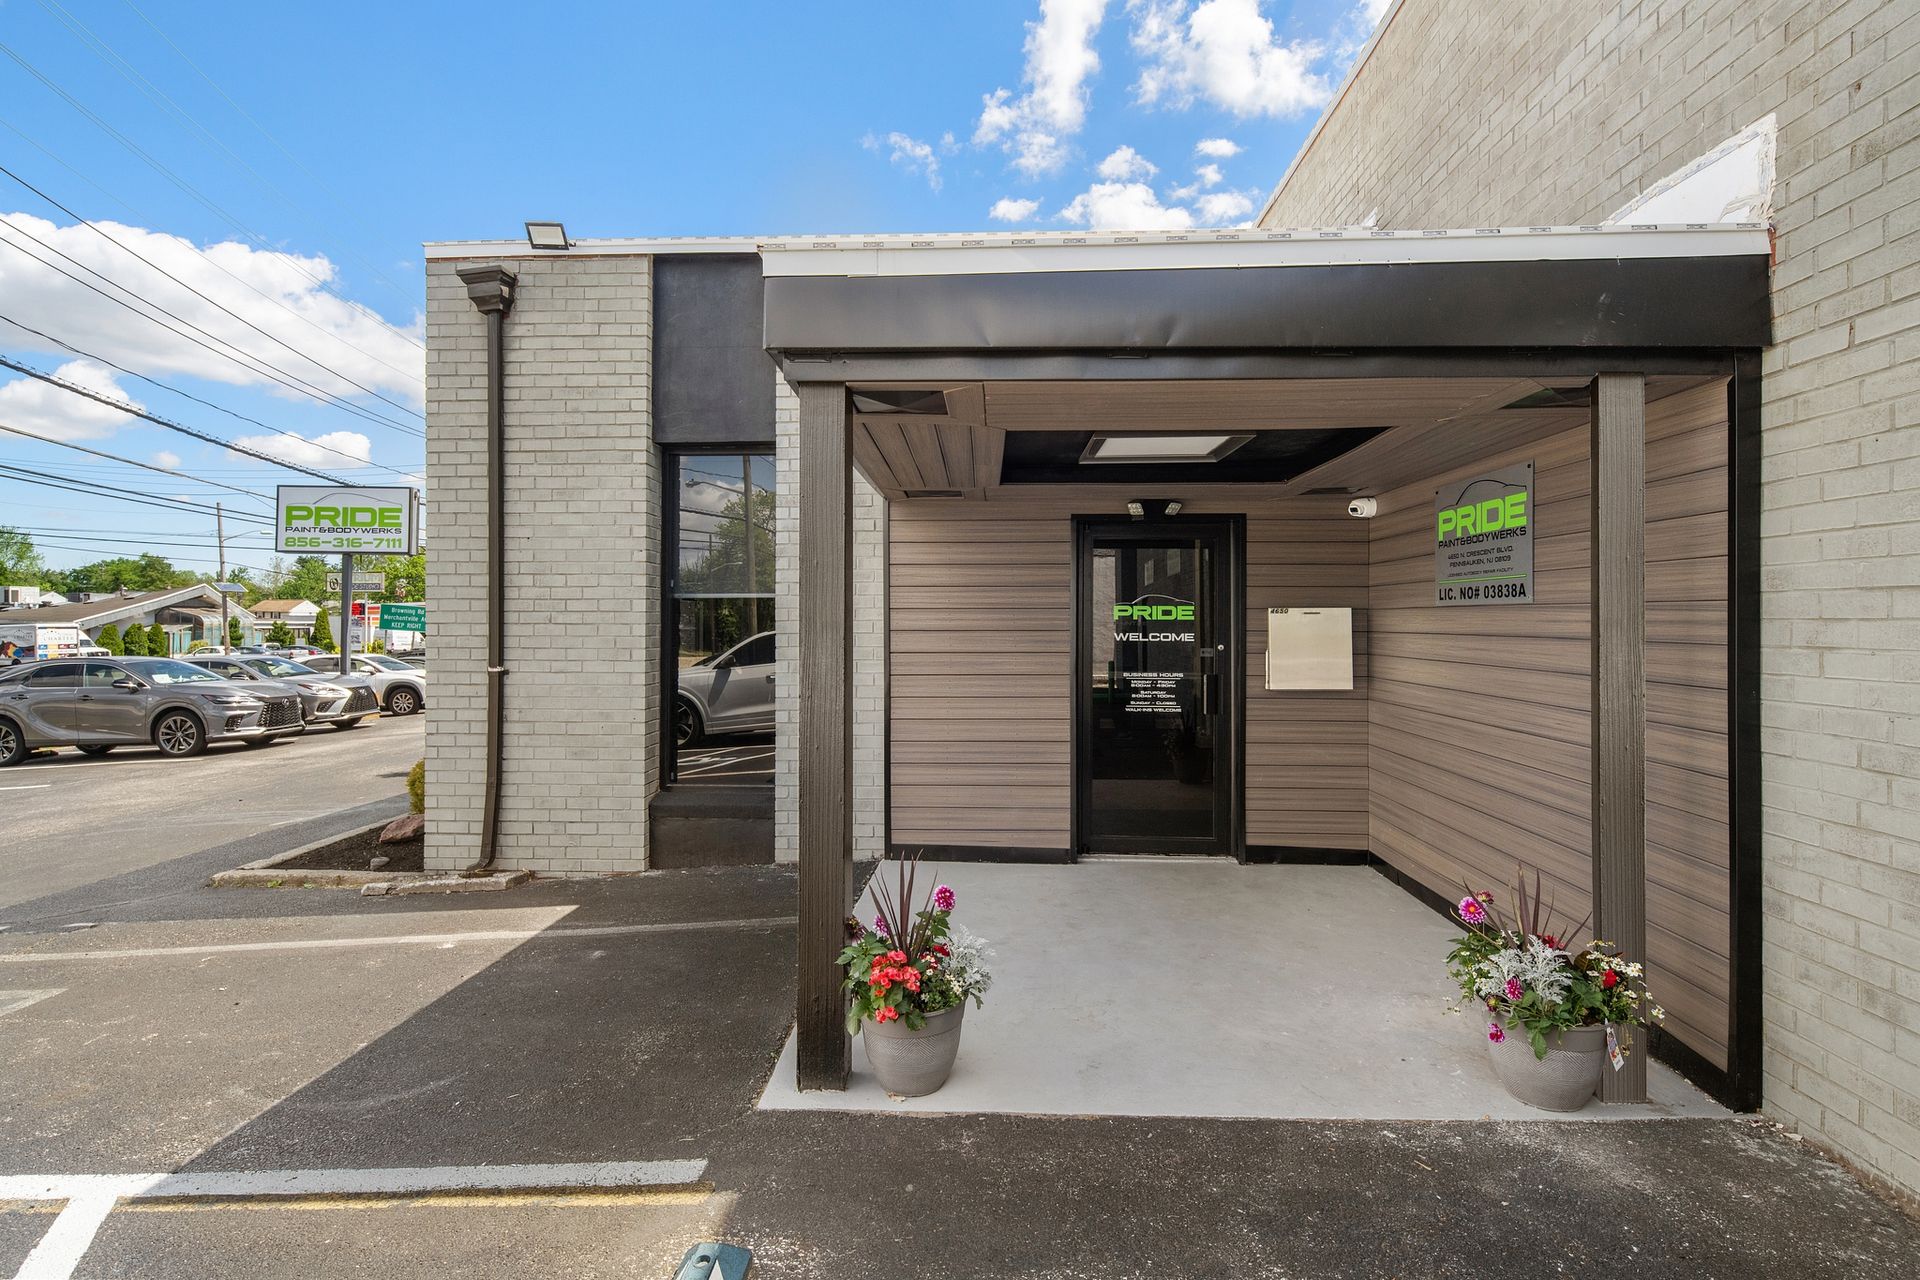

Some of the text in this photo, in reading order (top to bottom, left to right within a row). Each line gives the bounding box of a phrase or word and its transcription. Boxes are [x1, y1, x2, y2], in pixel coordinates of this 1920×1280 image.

[285, 505, 402, 527] PRIDE
[1438, 492, 1527, 542] PRIDE
[285, 526, 402, 534] PAINT&BODYWERKS
[1438, 526, 1527, 549] PAINT&BODYWERKS
[284, 537, 402, 548] 856-316-7111
[1466, 548, 1495, 558] CRESCENT
[1439, 583, 1526, 601] LIC. NO# 03838A
[1113, 605, 1195, 620] PRIDE
[1114, 633, 1194, 642] WELCOME
